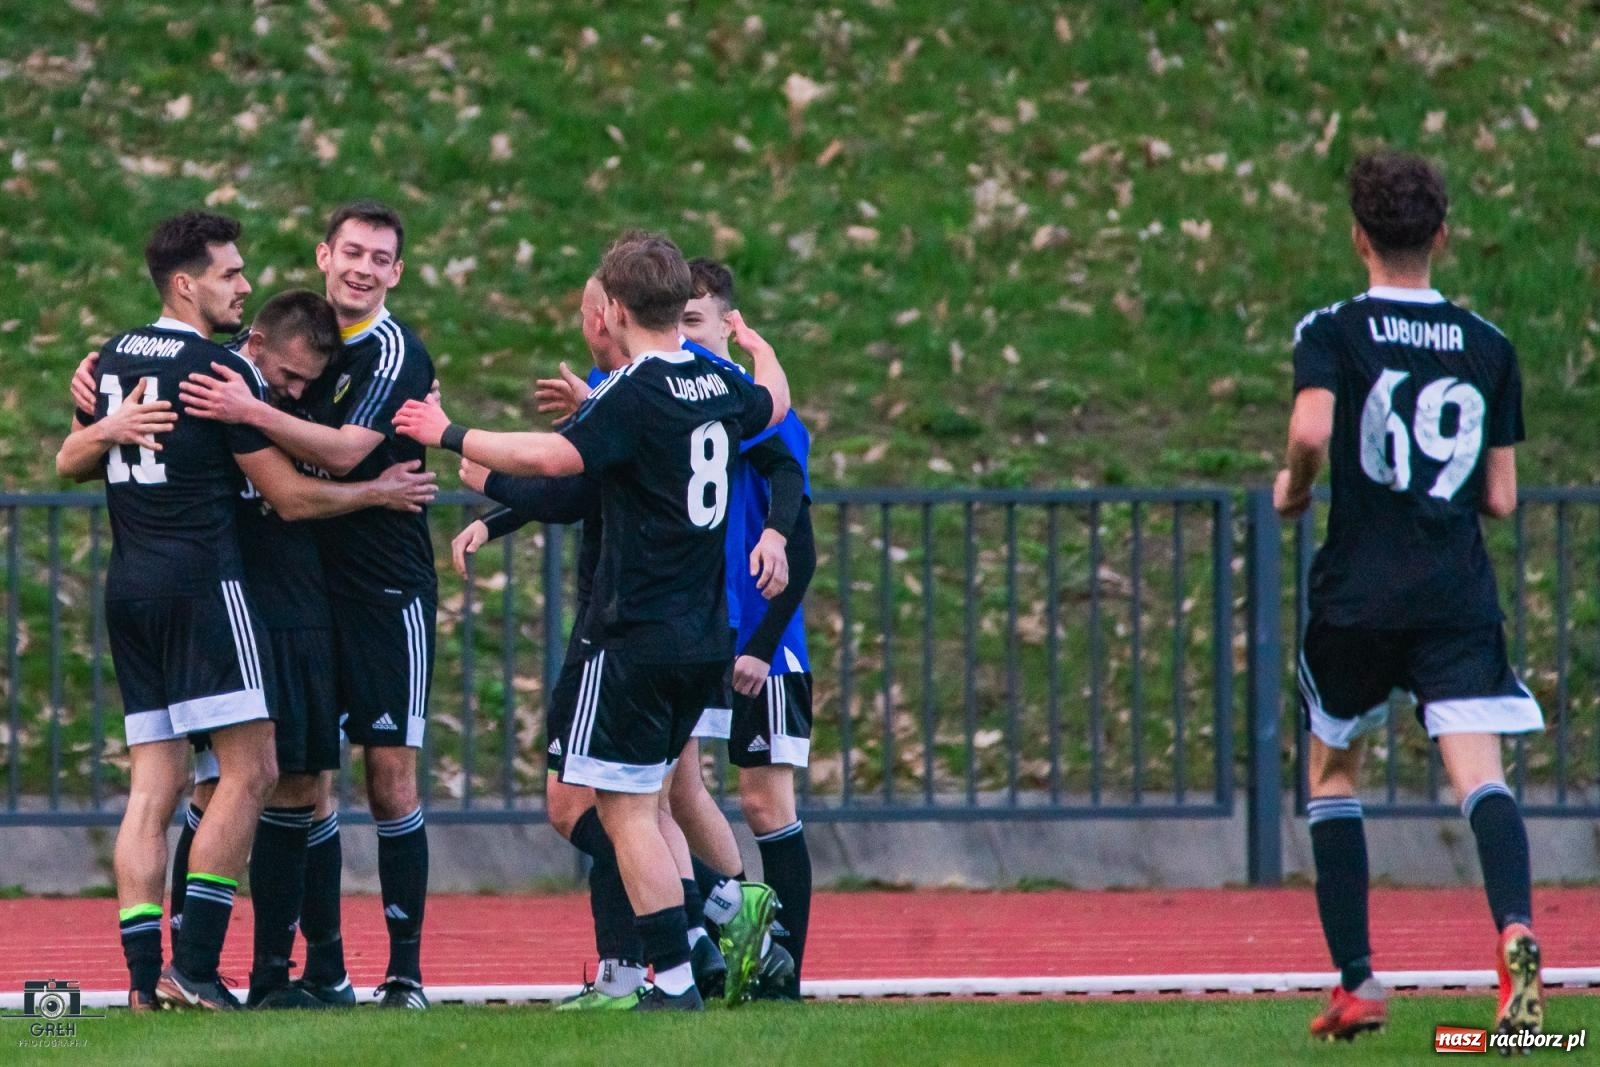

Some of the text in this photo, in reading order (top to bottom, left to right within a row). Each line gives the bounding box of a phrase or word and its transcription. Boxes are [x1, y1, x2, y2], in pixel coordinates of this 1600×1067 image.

[115, 334, 185, 358] LUBOMIA
[1368, 316, 1464, 351] LUBOMIA
[665, 373, 729, 401] LUBOMIA
[99, 373, 168, 484] 11
[1360, 367, 1486, 501] 69
[687, 420, 729, 529] 8
